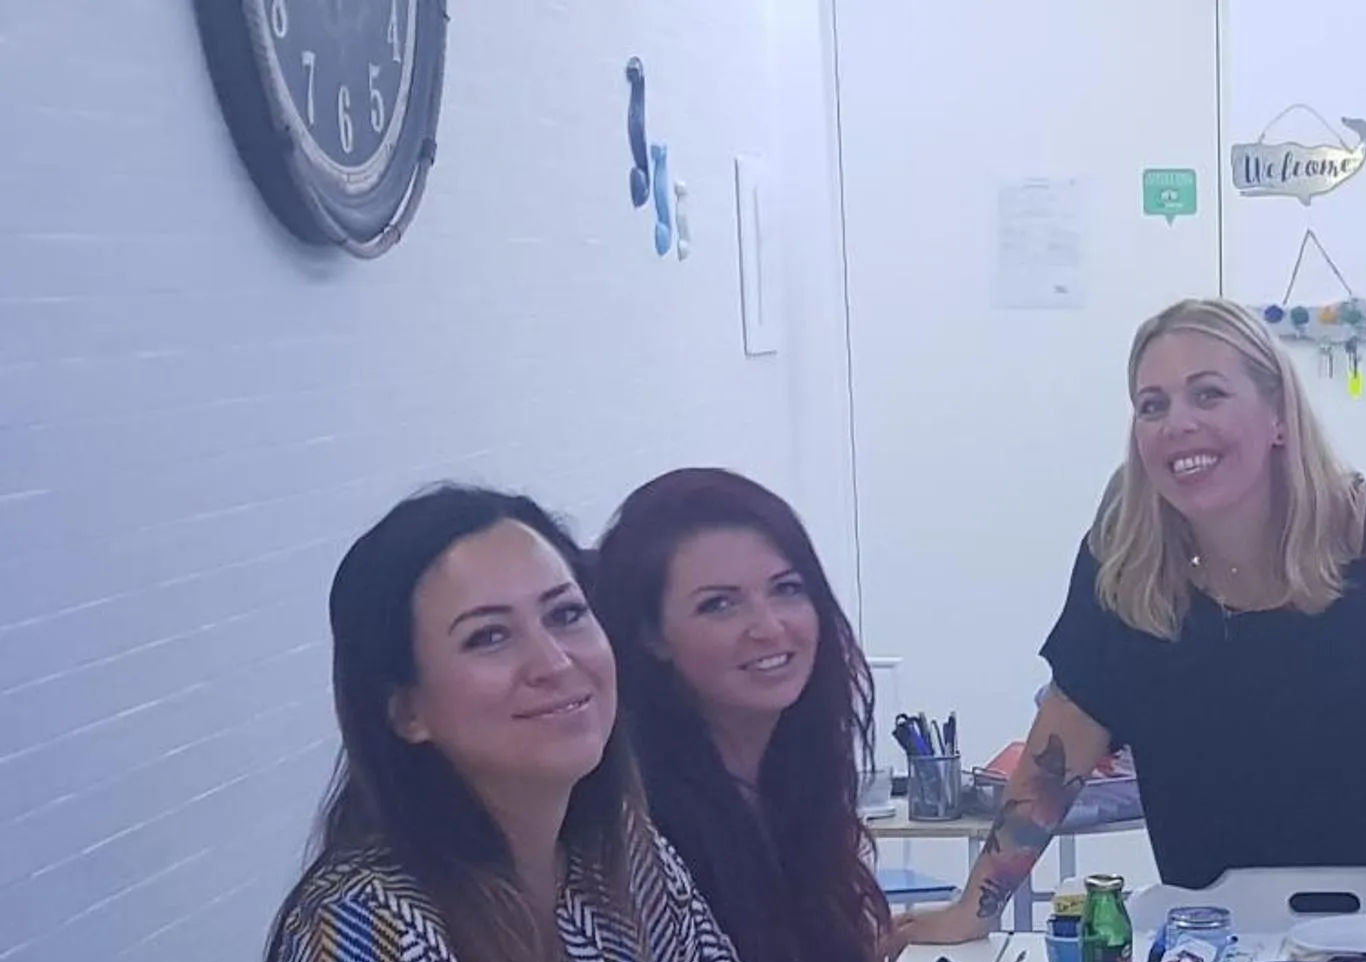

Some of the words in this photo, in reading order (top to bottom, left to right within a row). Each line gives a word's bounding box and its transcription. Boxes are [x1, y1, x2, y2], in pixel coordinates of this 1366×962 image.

[302, 51, 316, 126] 7
[337, 85, 353, 153] 6
[368, 62, 385, 133] 5
[1244, 149, 1351, 185] Welcome
